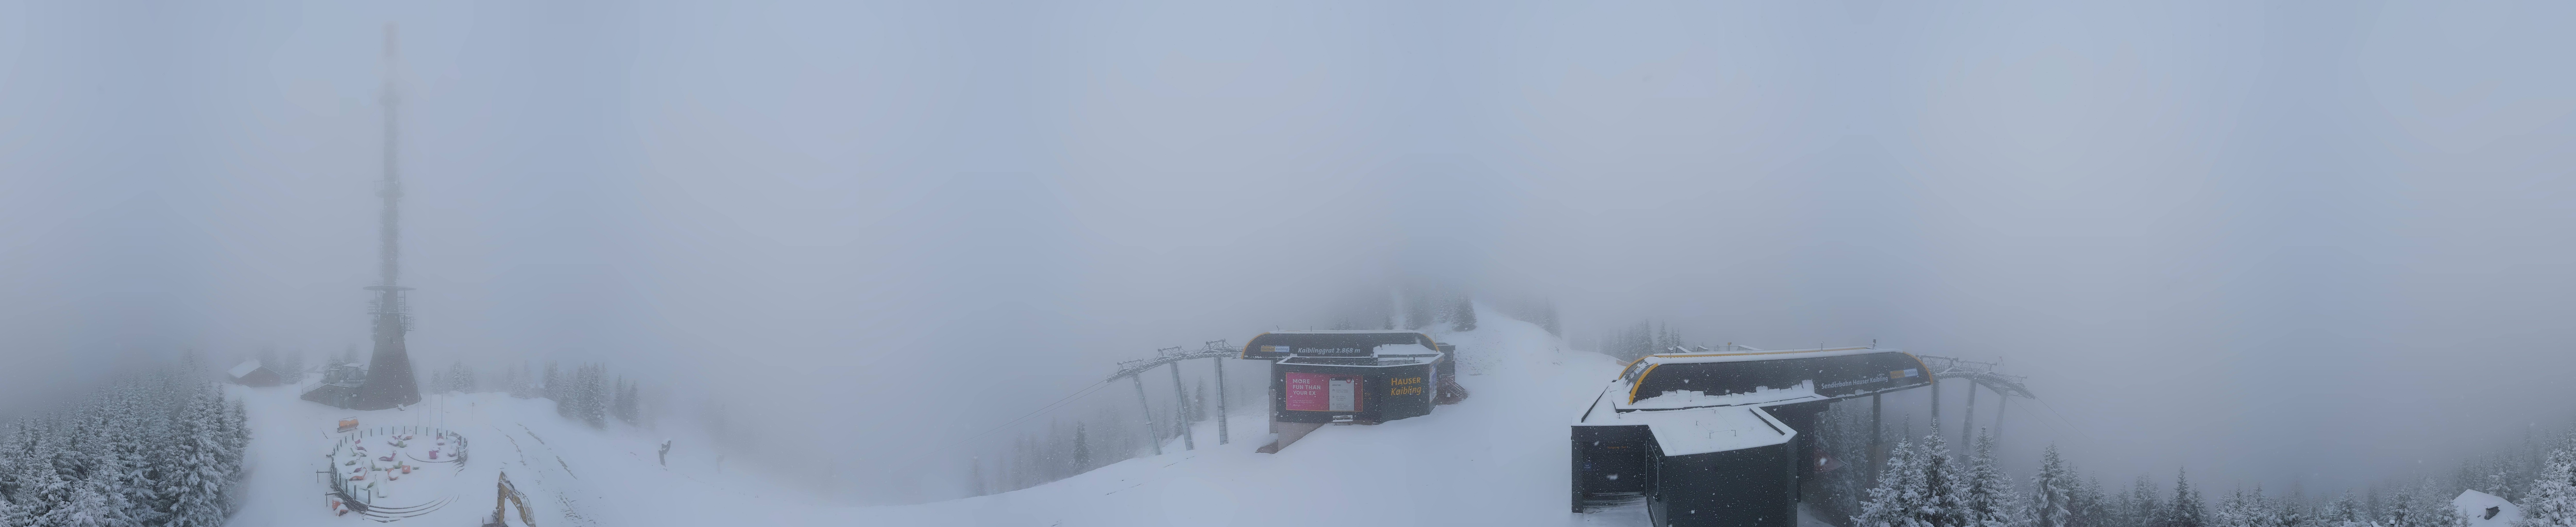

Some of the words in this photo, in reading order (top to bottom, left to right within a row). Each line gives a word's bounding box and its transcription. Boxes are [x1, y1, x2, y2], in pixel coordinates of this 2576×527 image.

[1391, 377, 1421, 386] HAUSER
[1821, 380, 1852, 389] Senderbahn
[1391, 386, 1421, 396] Kaibling
